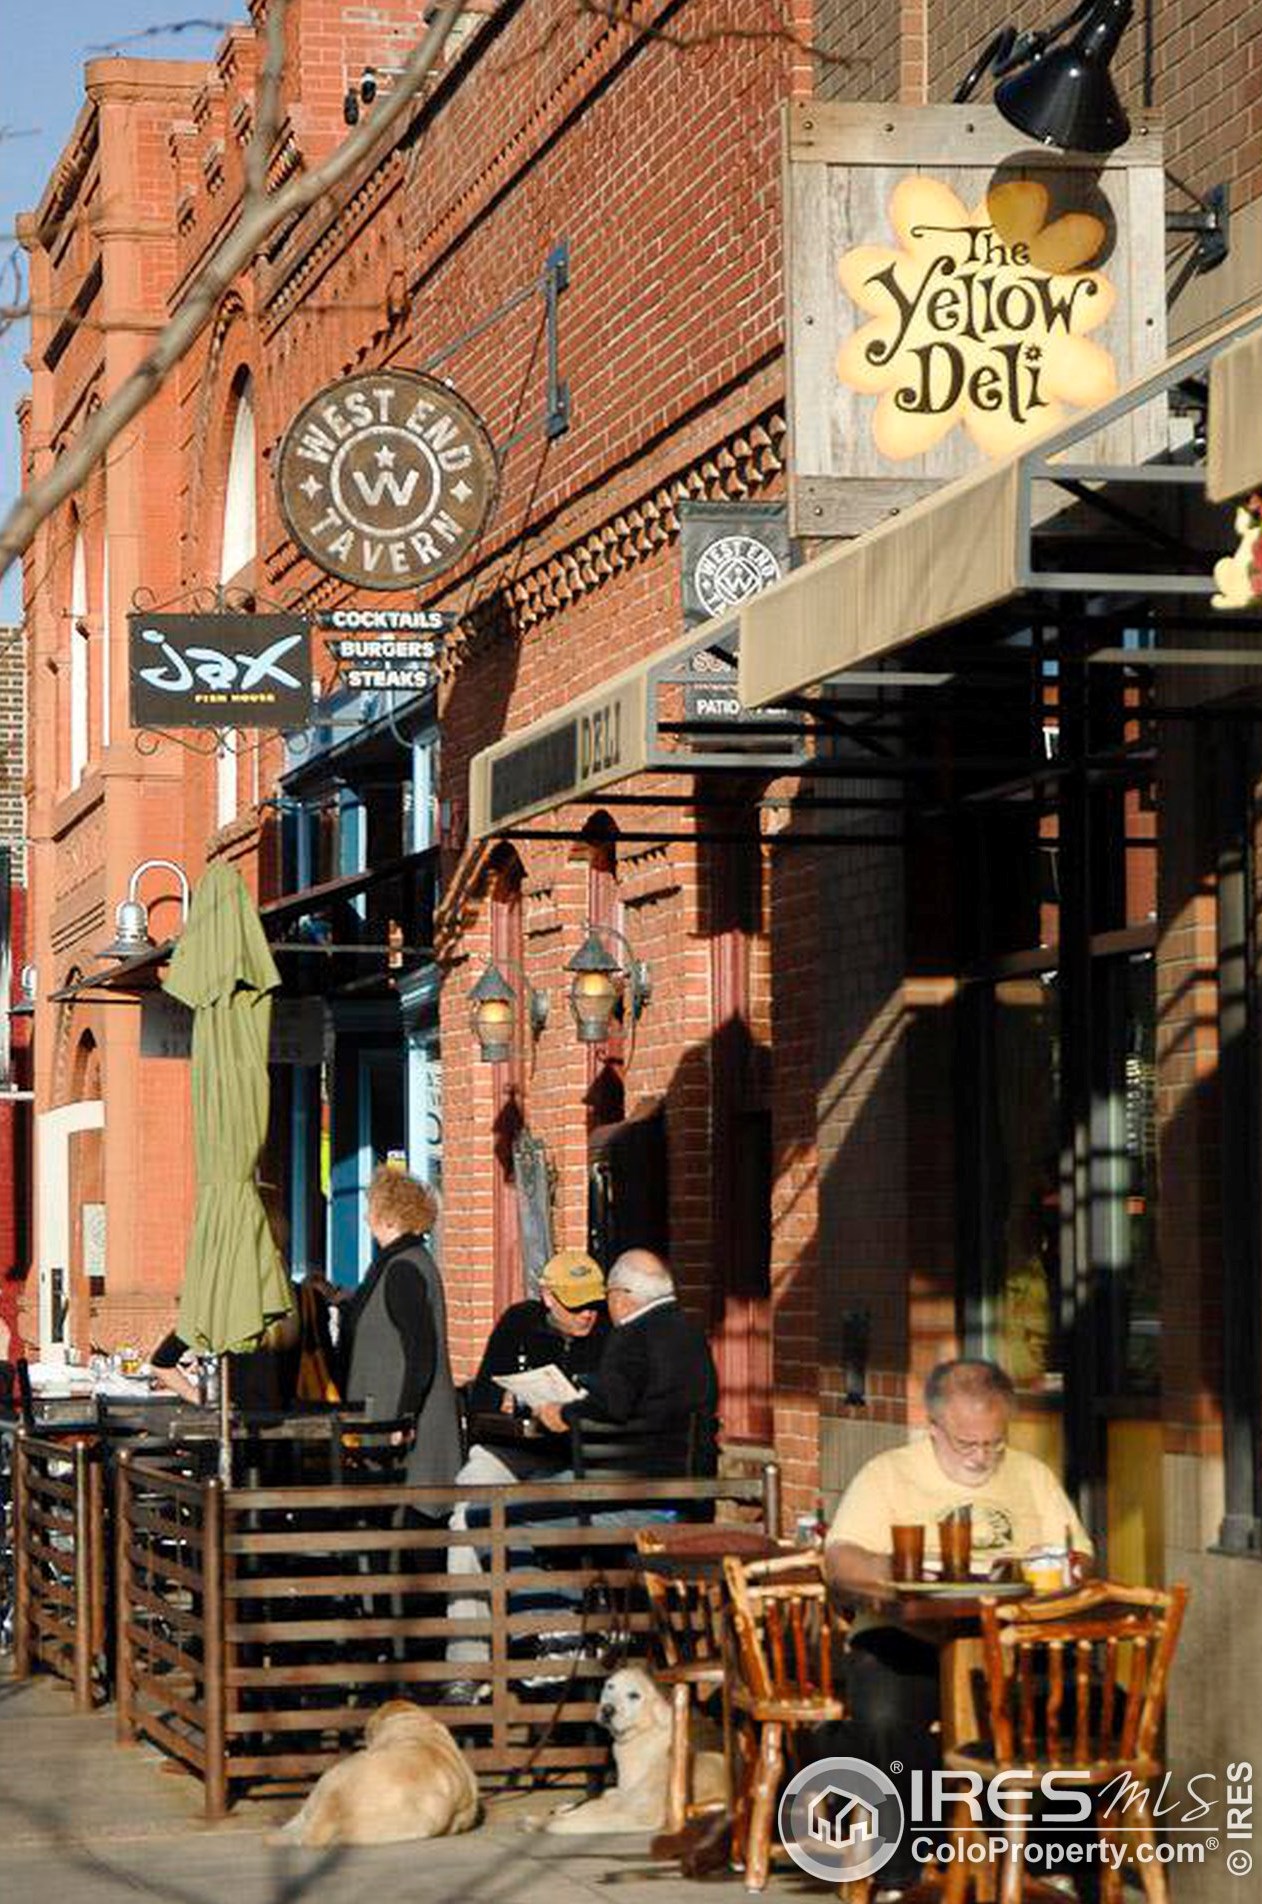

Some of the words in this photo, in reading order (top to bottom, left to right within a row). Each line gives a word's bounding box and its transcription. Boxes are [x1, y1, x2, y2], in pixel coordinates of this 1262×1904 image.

[911, 224, 1031, 267] The
[864, 255, 1099, 367] Yellow
[894, 341, 1050, 424] Deli
[296, 388, 396, 465] WEST
[404, 398, 473, 472] END
[352, 468, 420, 506] W
[310, 506, 464, 574] TAVERN
[700, 540, 741, 577] WEST
[332, 610, 443, 629] COCKTAILS
[340, 640, 436, 658] BURGERS
[348, 669, 428, 688] STEAKS
[696, 699, 740, 715] PATIO
[581, 701, 621, 780] DELI
